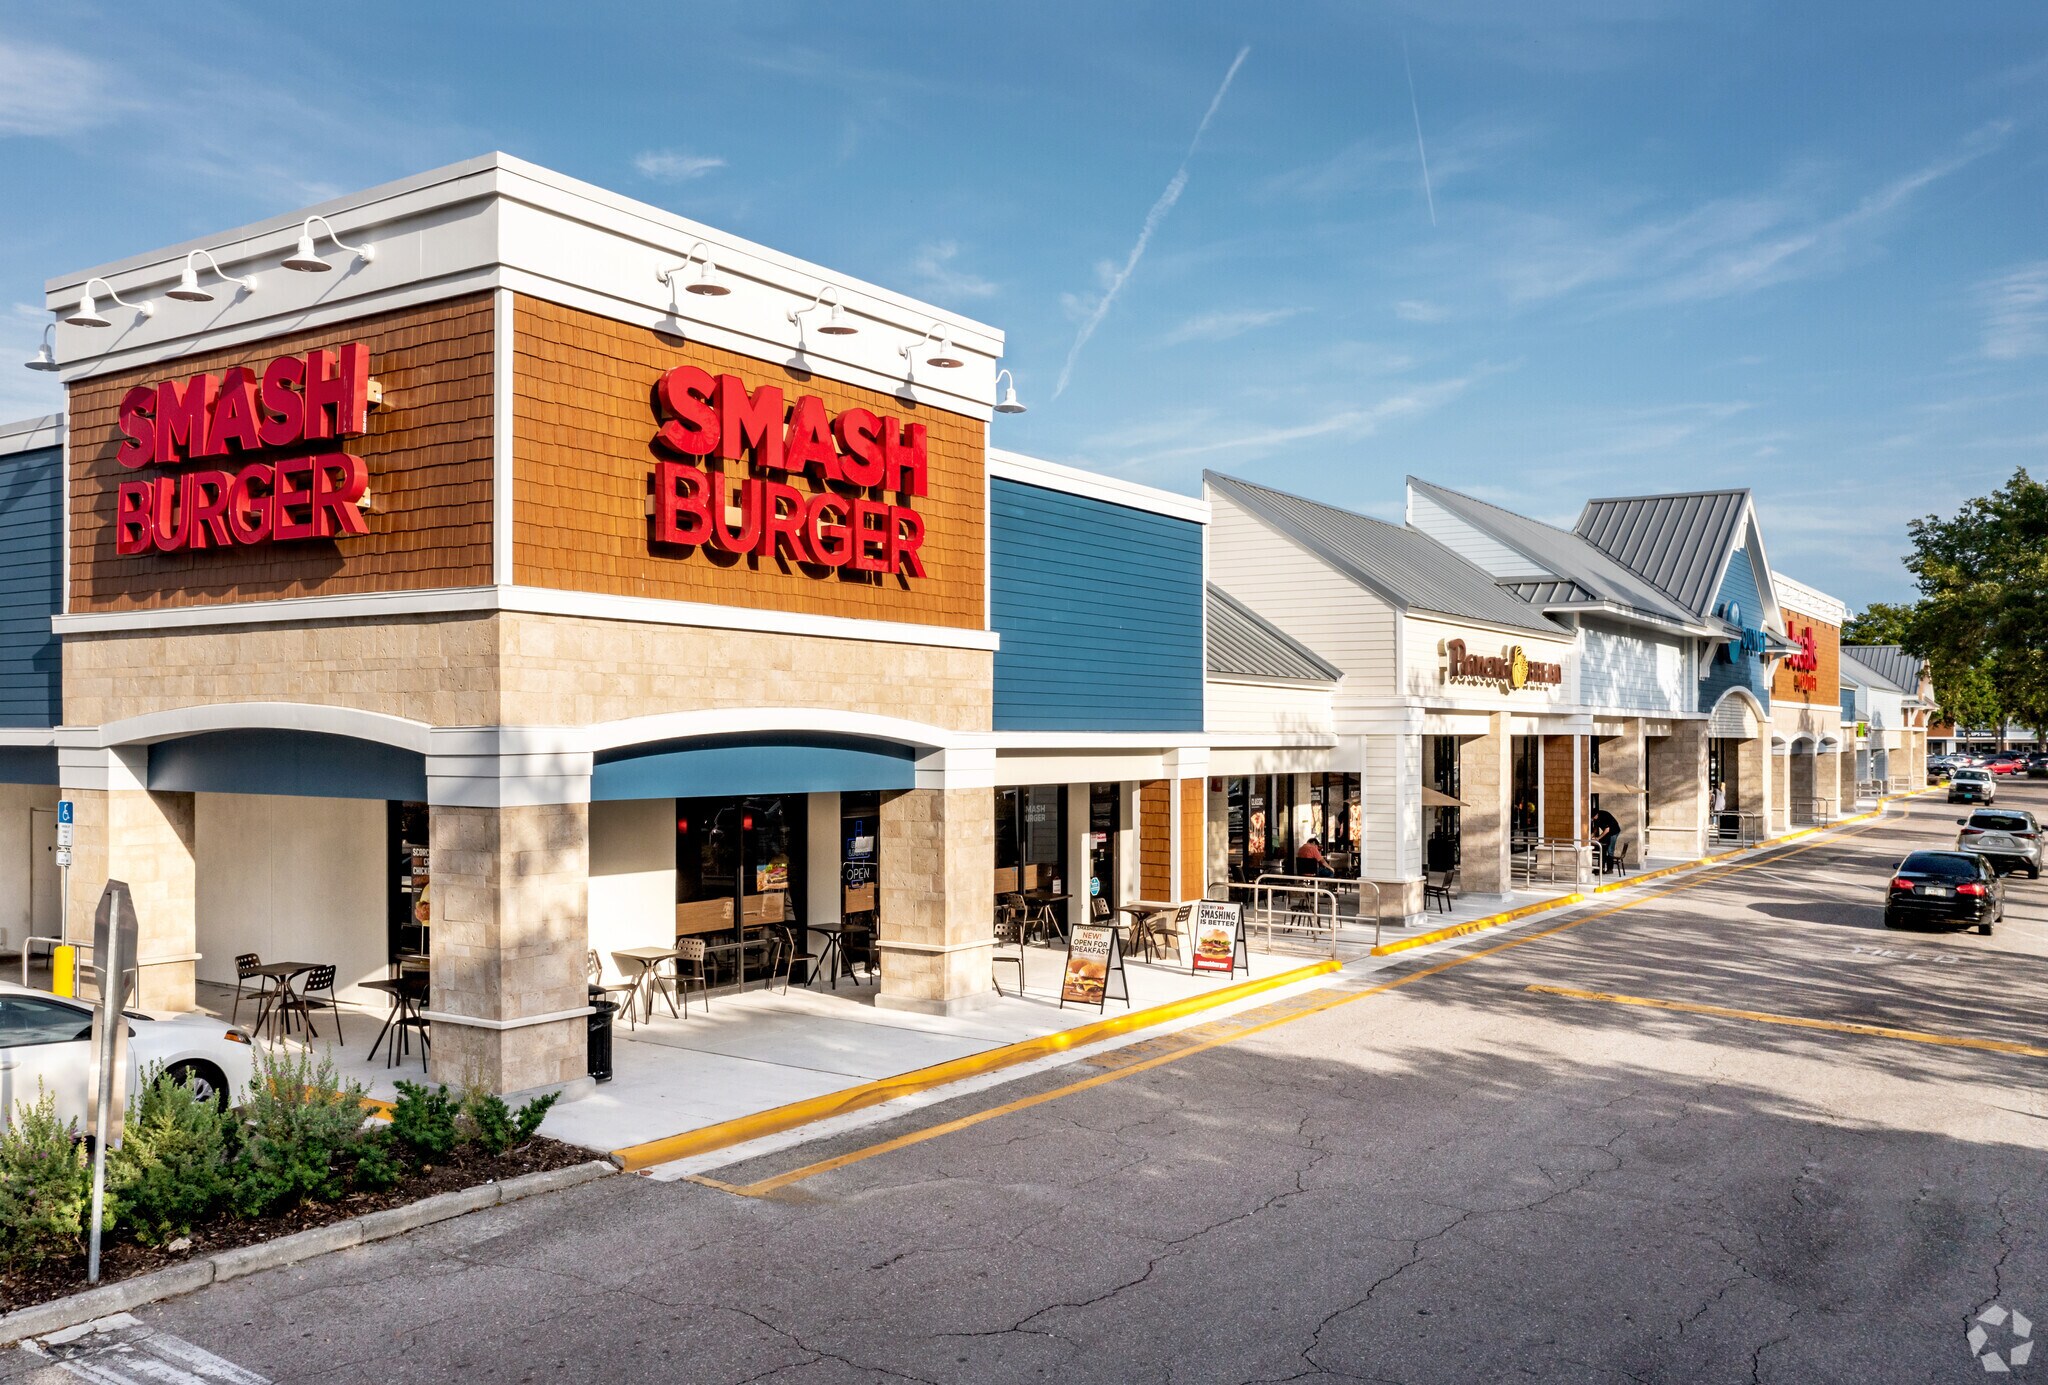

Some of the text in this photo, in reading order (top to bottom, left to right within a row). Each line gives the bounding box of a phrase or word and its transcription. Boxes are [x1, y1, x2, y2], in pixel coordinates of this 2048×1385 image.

[116, 342, 369, 468] SMASH
[657, 365, 928, 497] SMASH
[117, 453, 370, 555] BURGER
[655, 461, 928, 579] BURGER
[1025, 804, 1046, 813] MASH
[1025, 814, 1046, 823] URGER
[846, 867, 871, 881] OPEN
[1200, 909, 1236, 921] SMASHING
[1208, 919, 1235, 927] BETTER
[1083, 932, 1102, 940] NEW!
[1073, 939, 1108, 949] OPEN FOR
[1071, 945, 1110, 955] BREAKFAST
